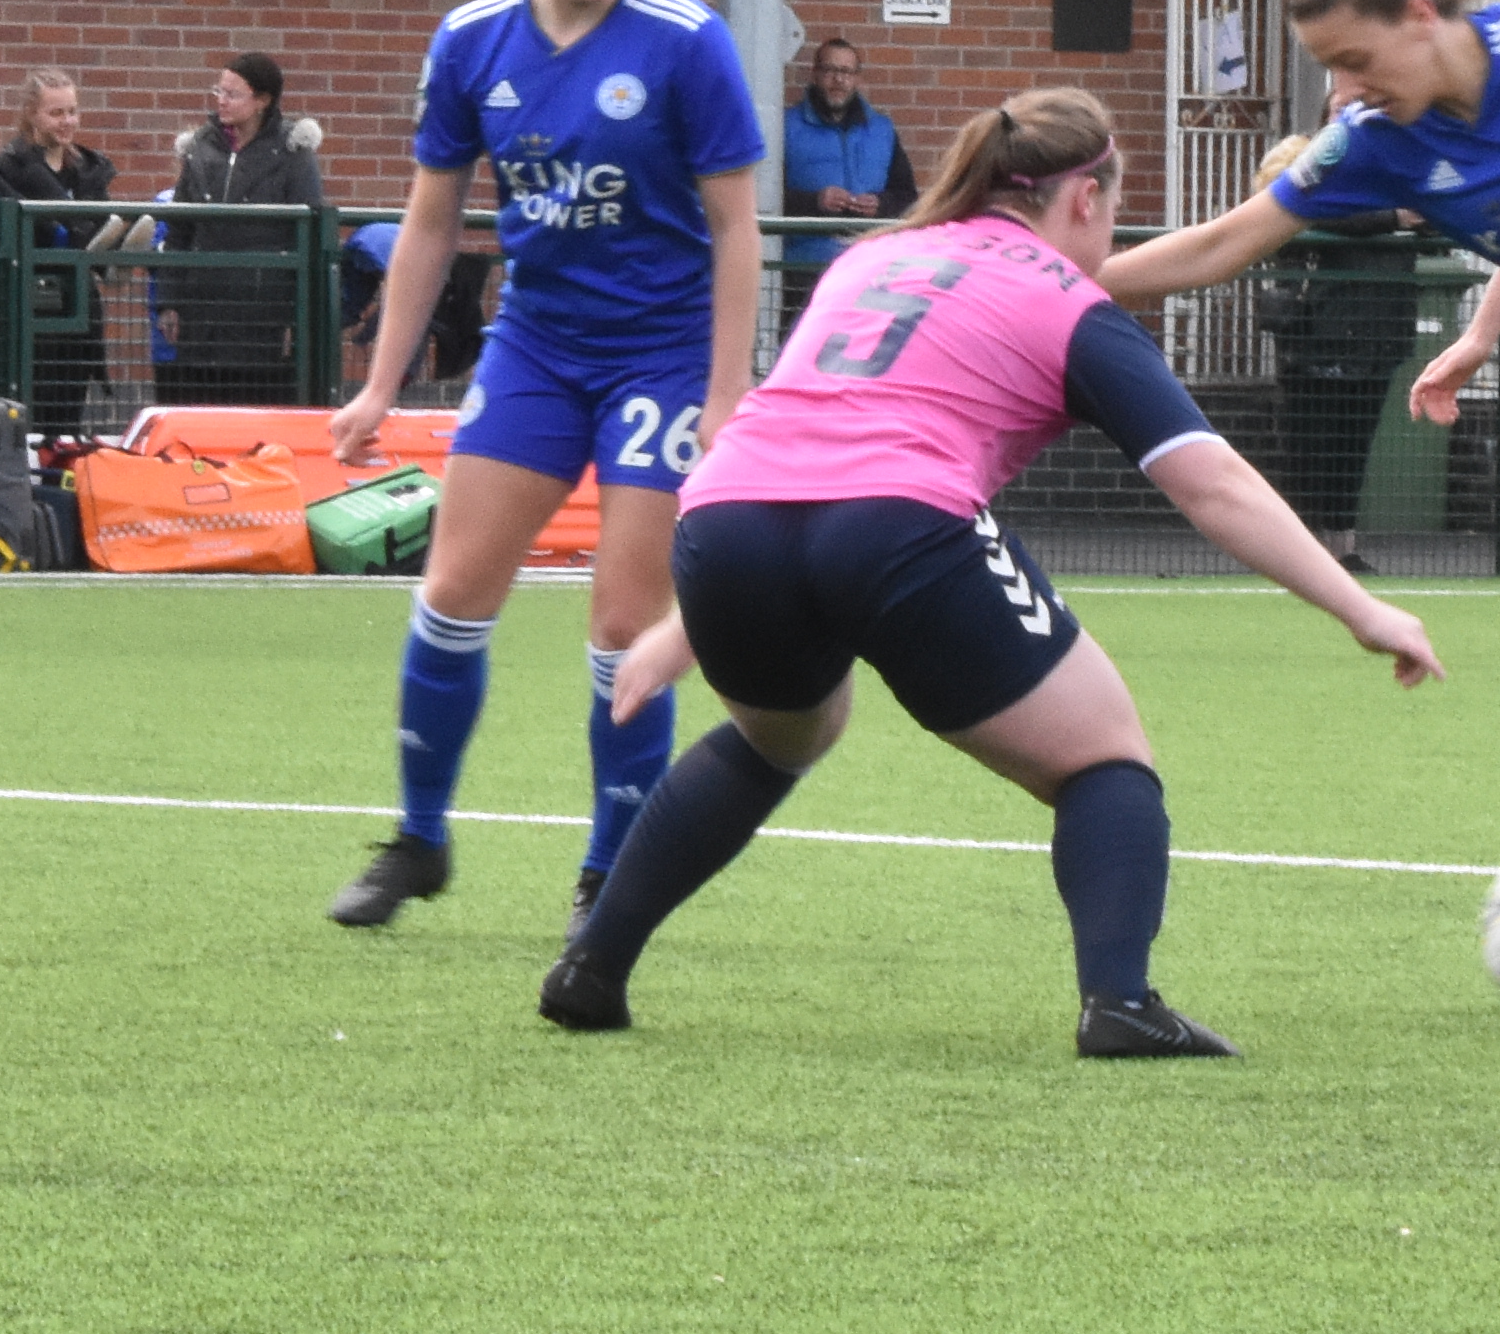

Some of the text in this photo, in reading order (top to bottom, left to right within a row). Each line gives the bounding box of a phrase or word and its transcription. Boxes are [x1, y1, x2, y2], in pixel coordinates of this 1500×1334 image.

[499, 160, 627, 200] KING
[815, 255, 971, 378] 5
[617, 397, 704, 475] 26
